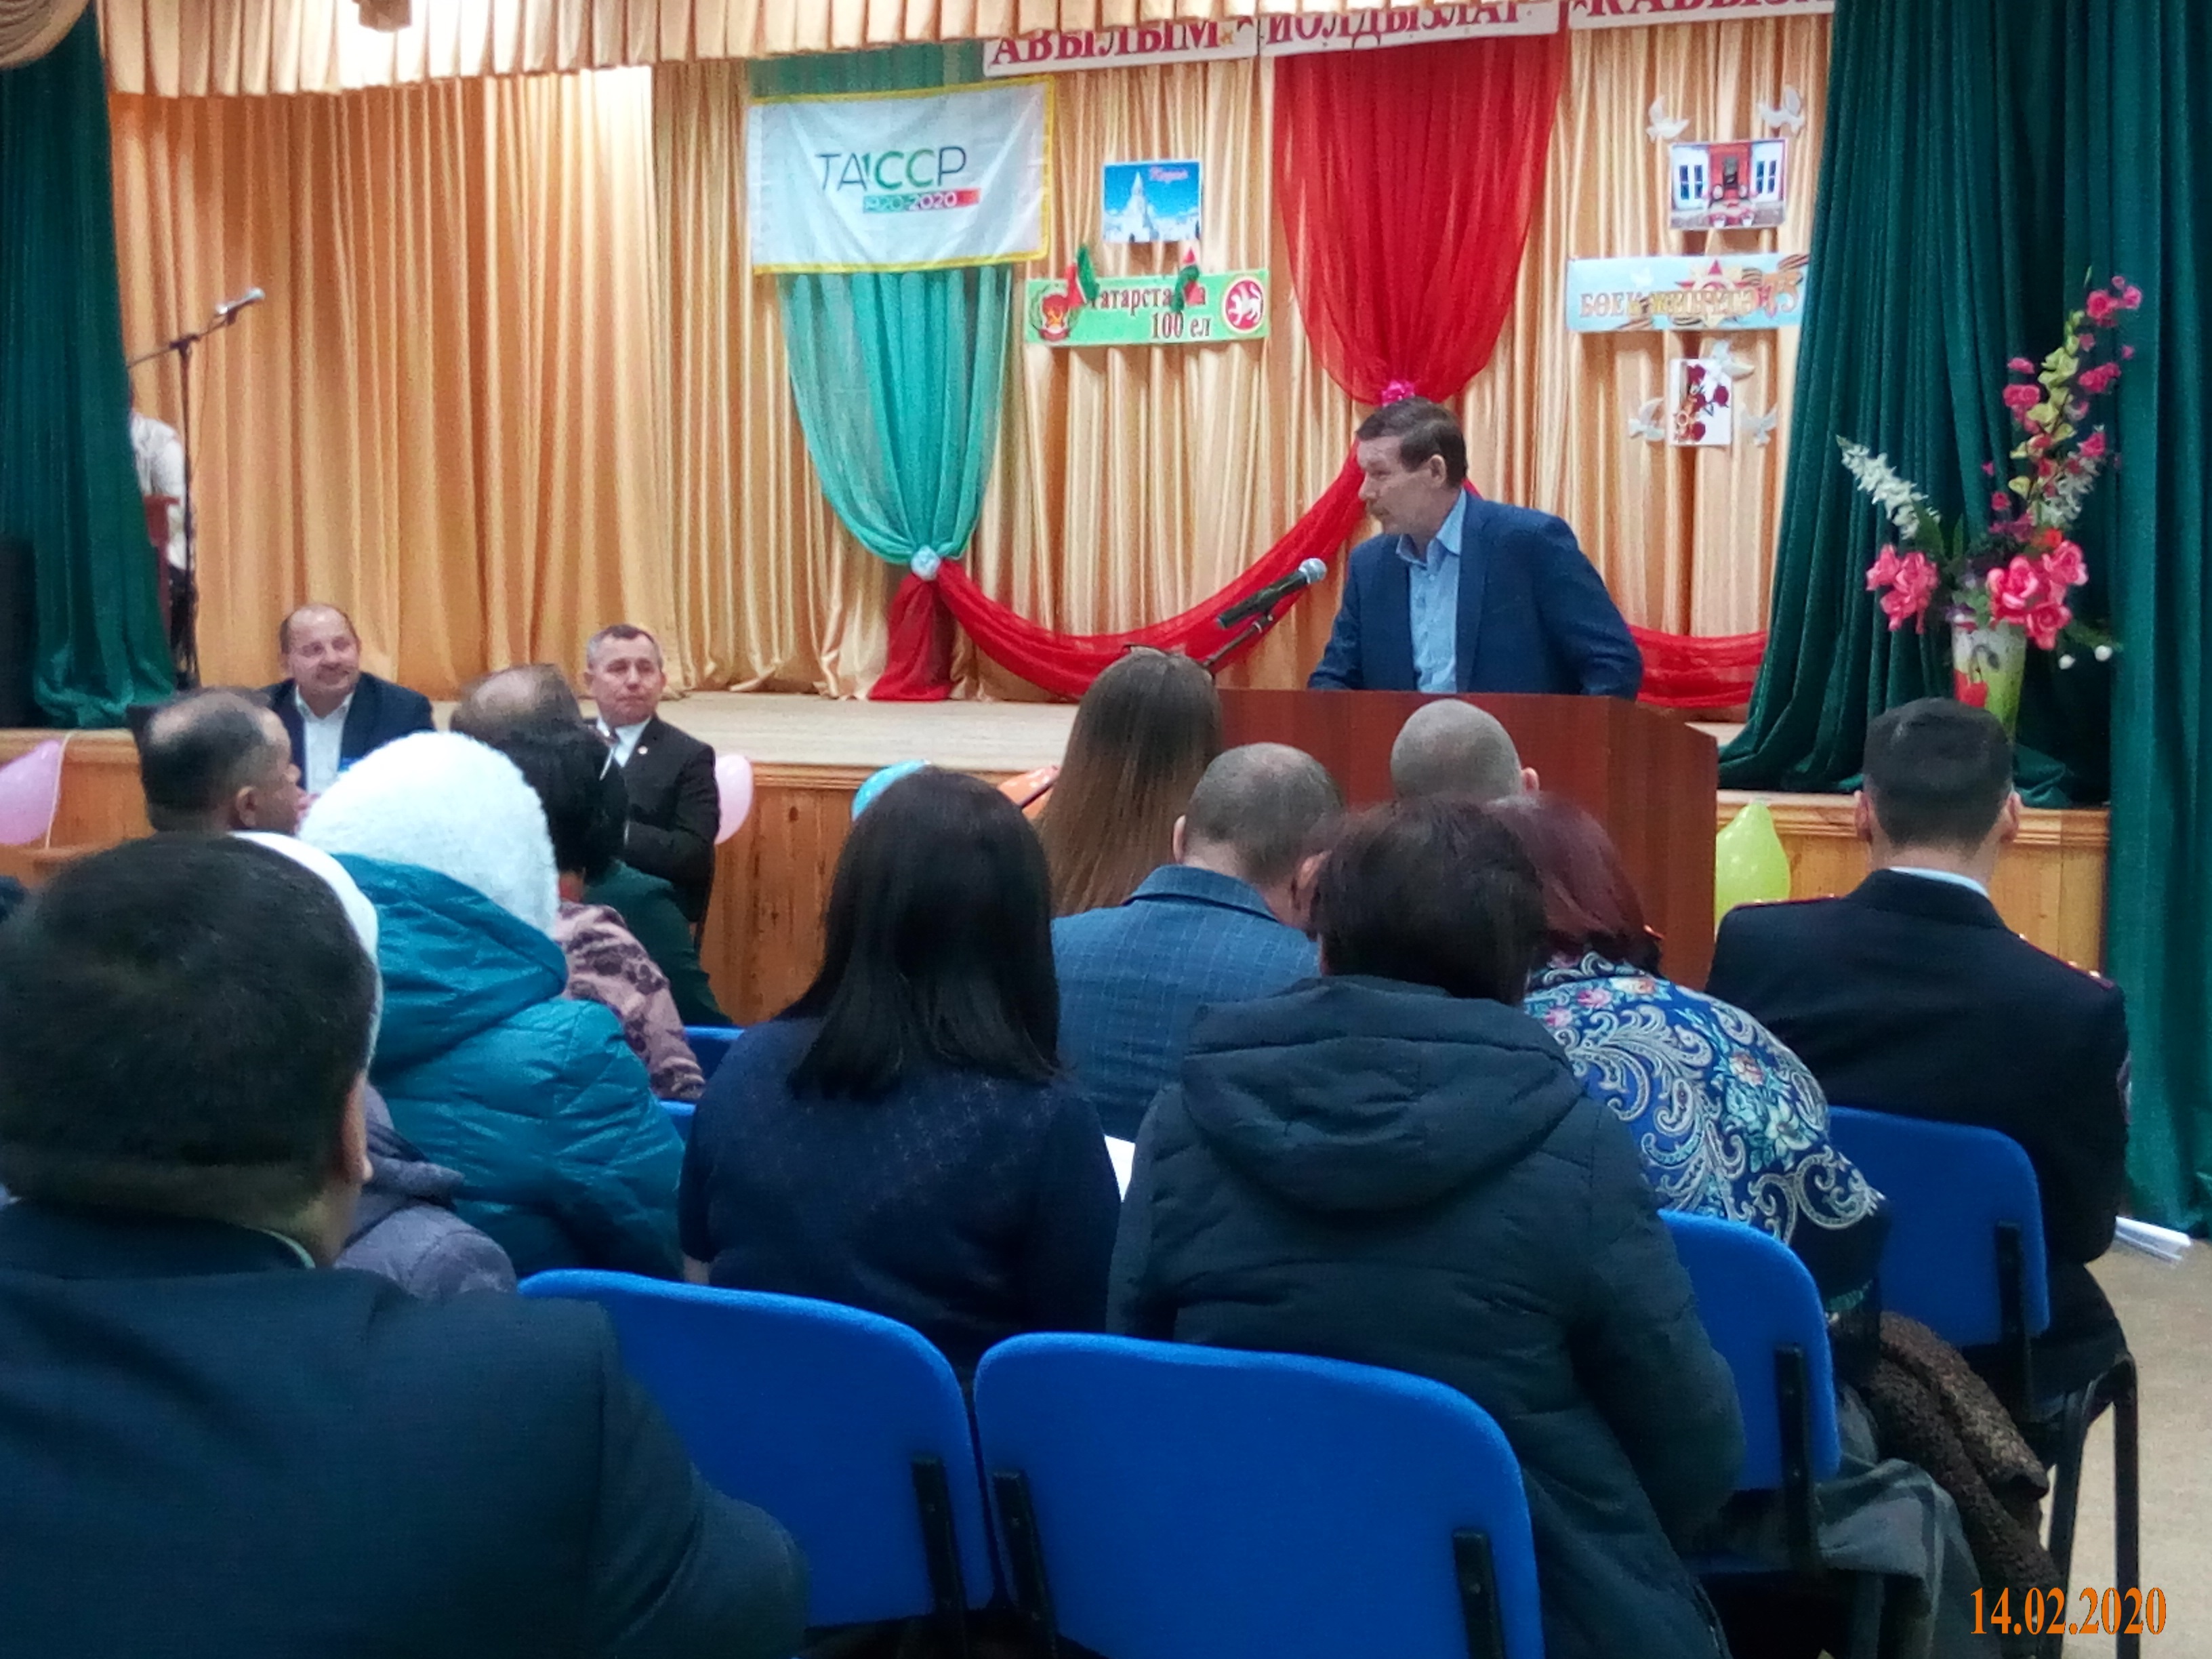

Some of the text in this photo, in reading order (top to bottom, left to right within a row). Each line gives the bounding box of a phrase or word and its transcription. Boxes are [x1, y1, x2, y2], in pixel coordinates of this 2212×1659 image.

[1090, 287, 1206, 316] атарста
[1153, 311, 1211, 339] 100 ел
